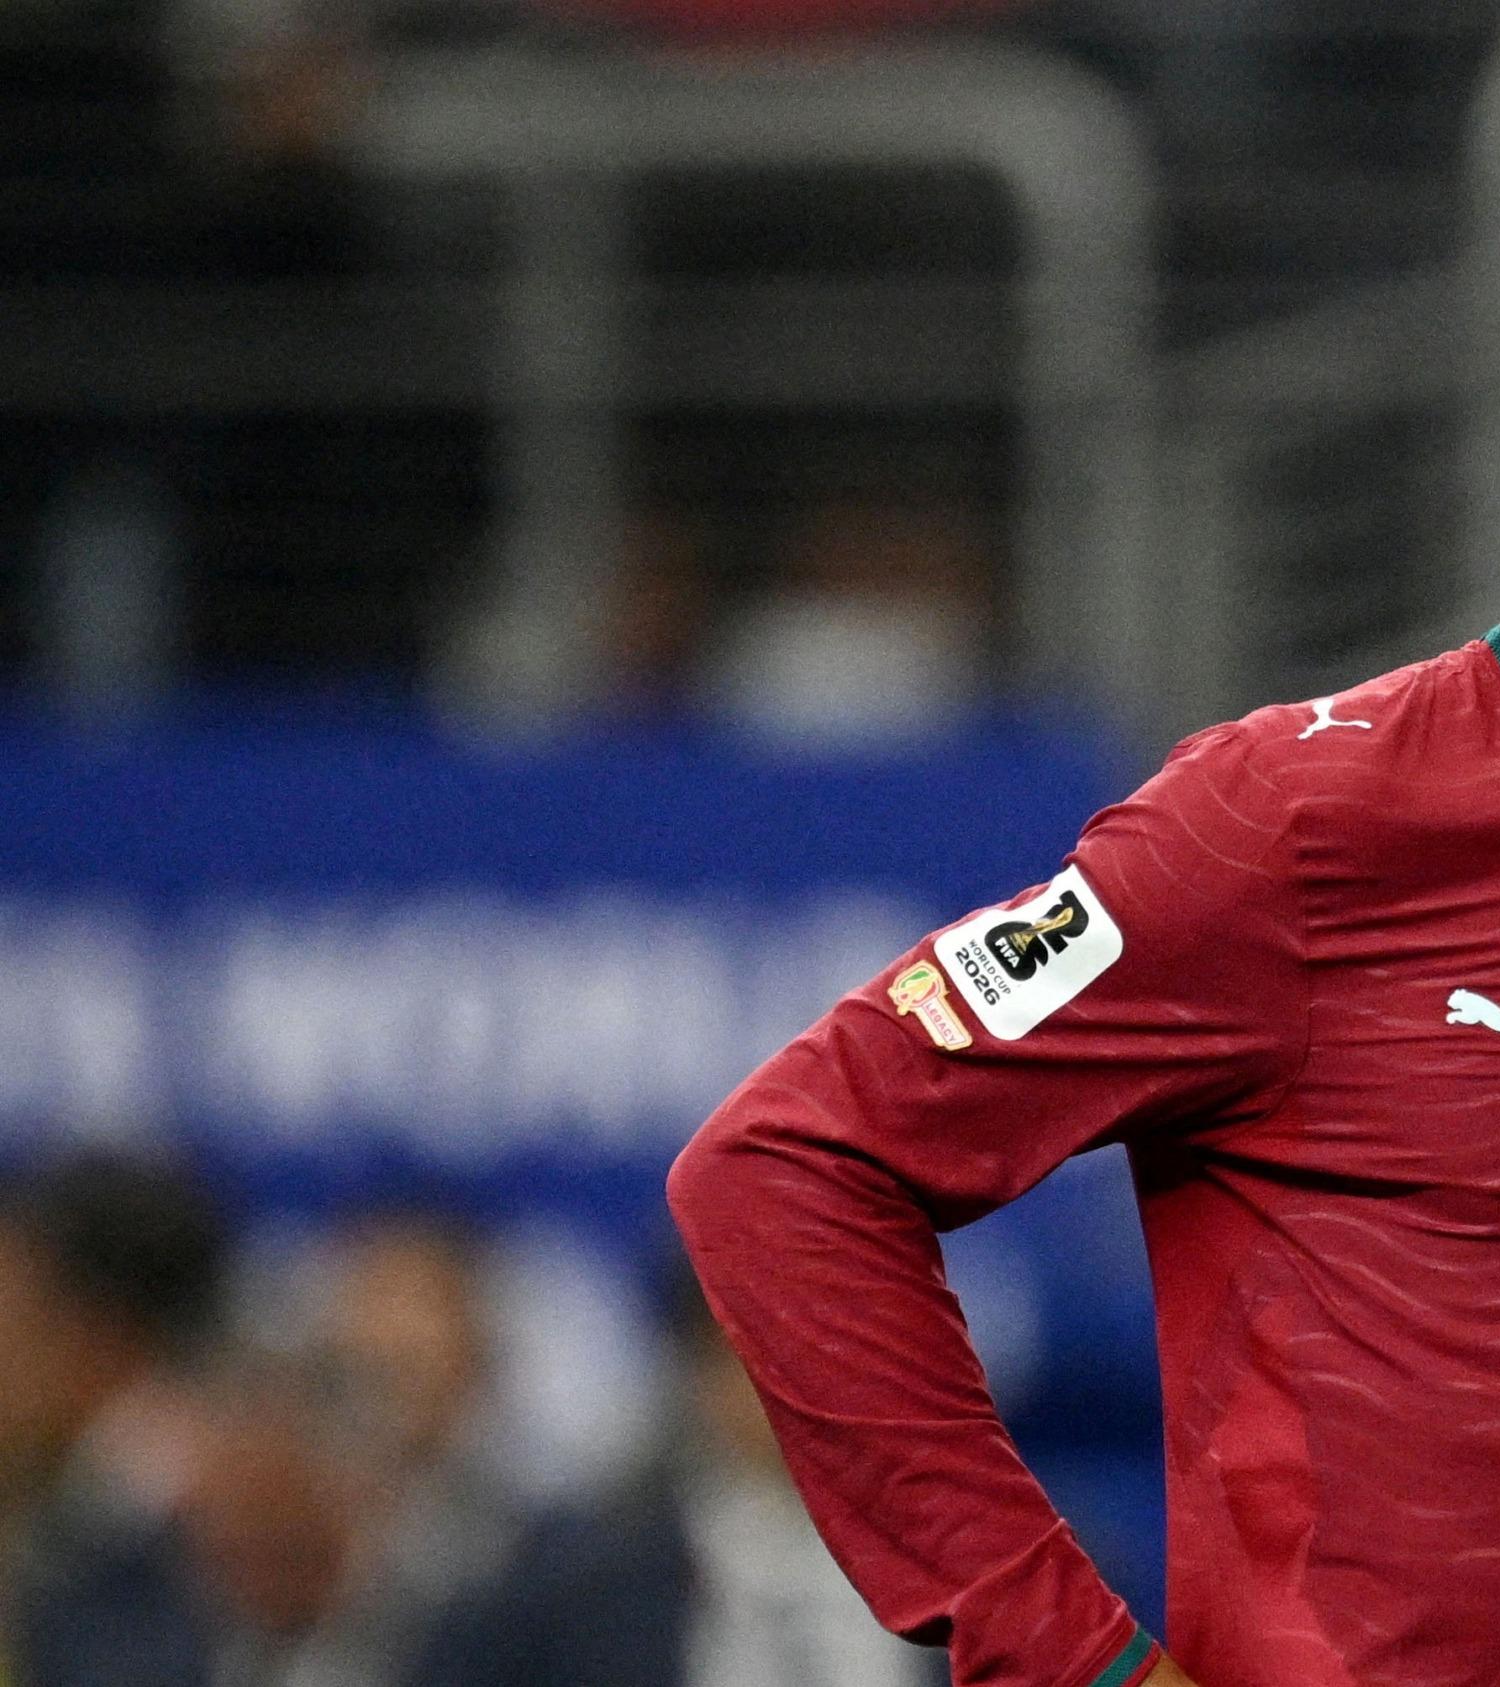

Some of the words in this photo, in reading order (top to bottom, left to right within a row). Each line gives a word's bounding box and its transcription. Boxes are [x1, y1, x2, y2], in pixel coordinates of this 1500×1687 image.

[968, 939, 996, 975] WORLD
[993, 974, 1011, 995] CUP
[994, 936, 1021, 968] FIFA
[955, 947, 1000, 1006] 2026
[926, 1002, 957, 1042] LEGACY
